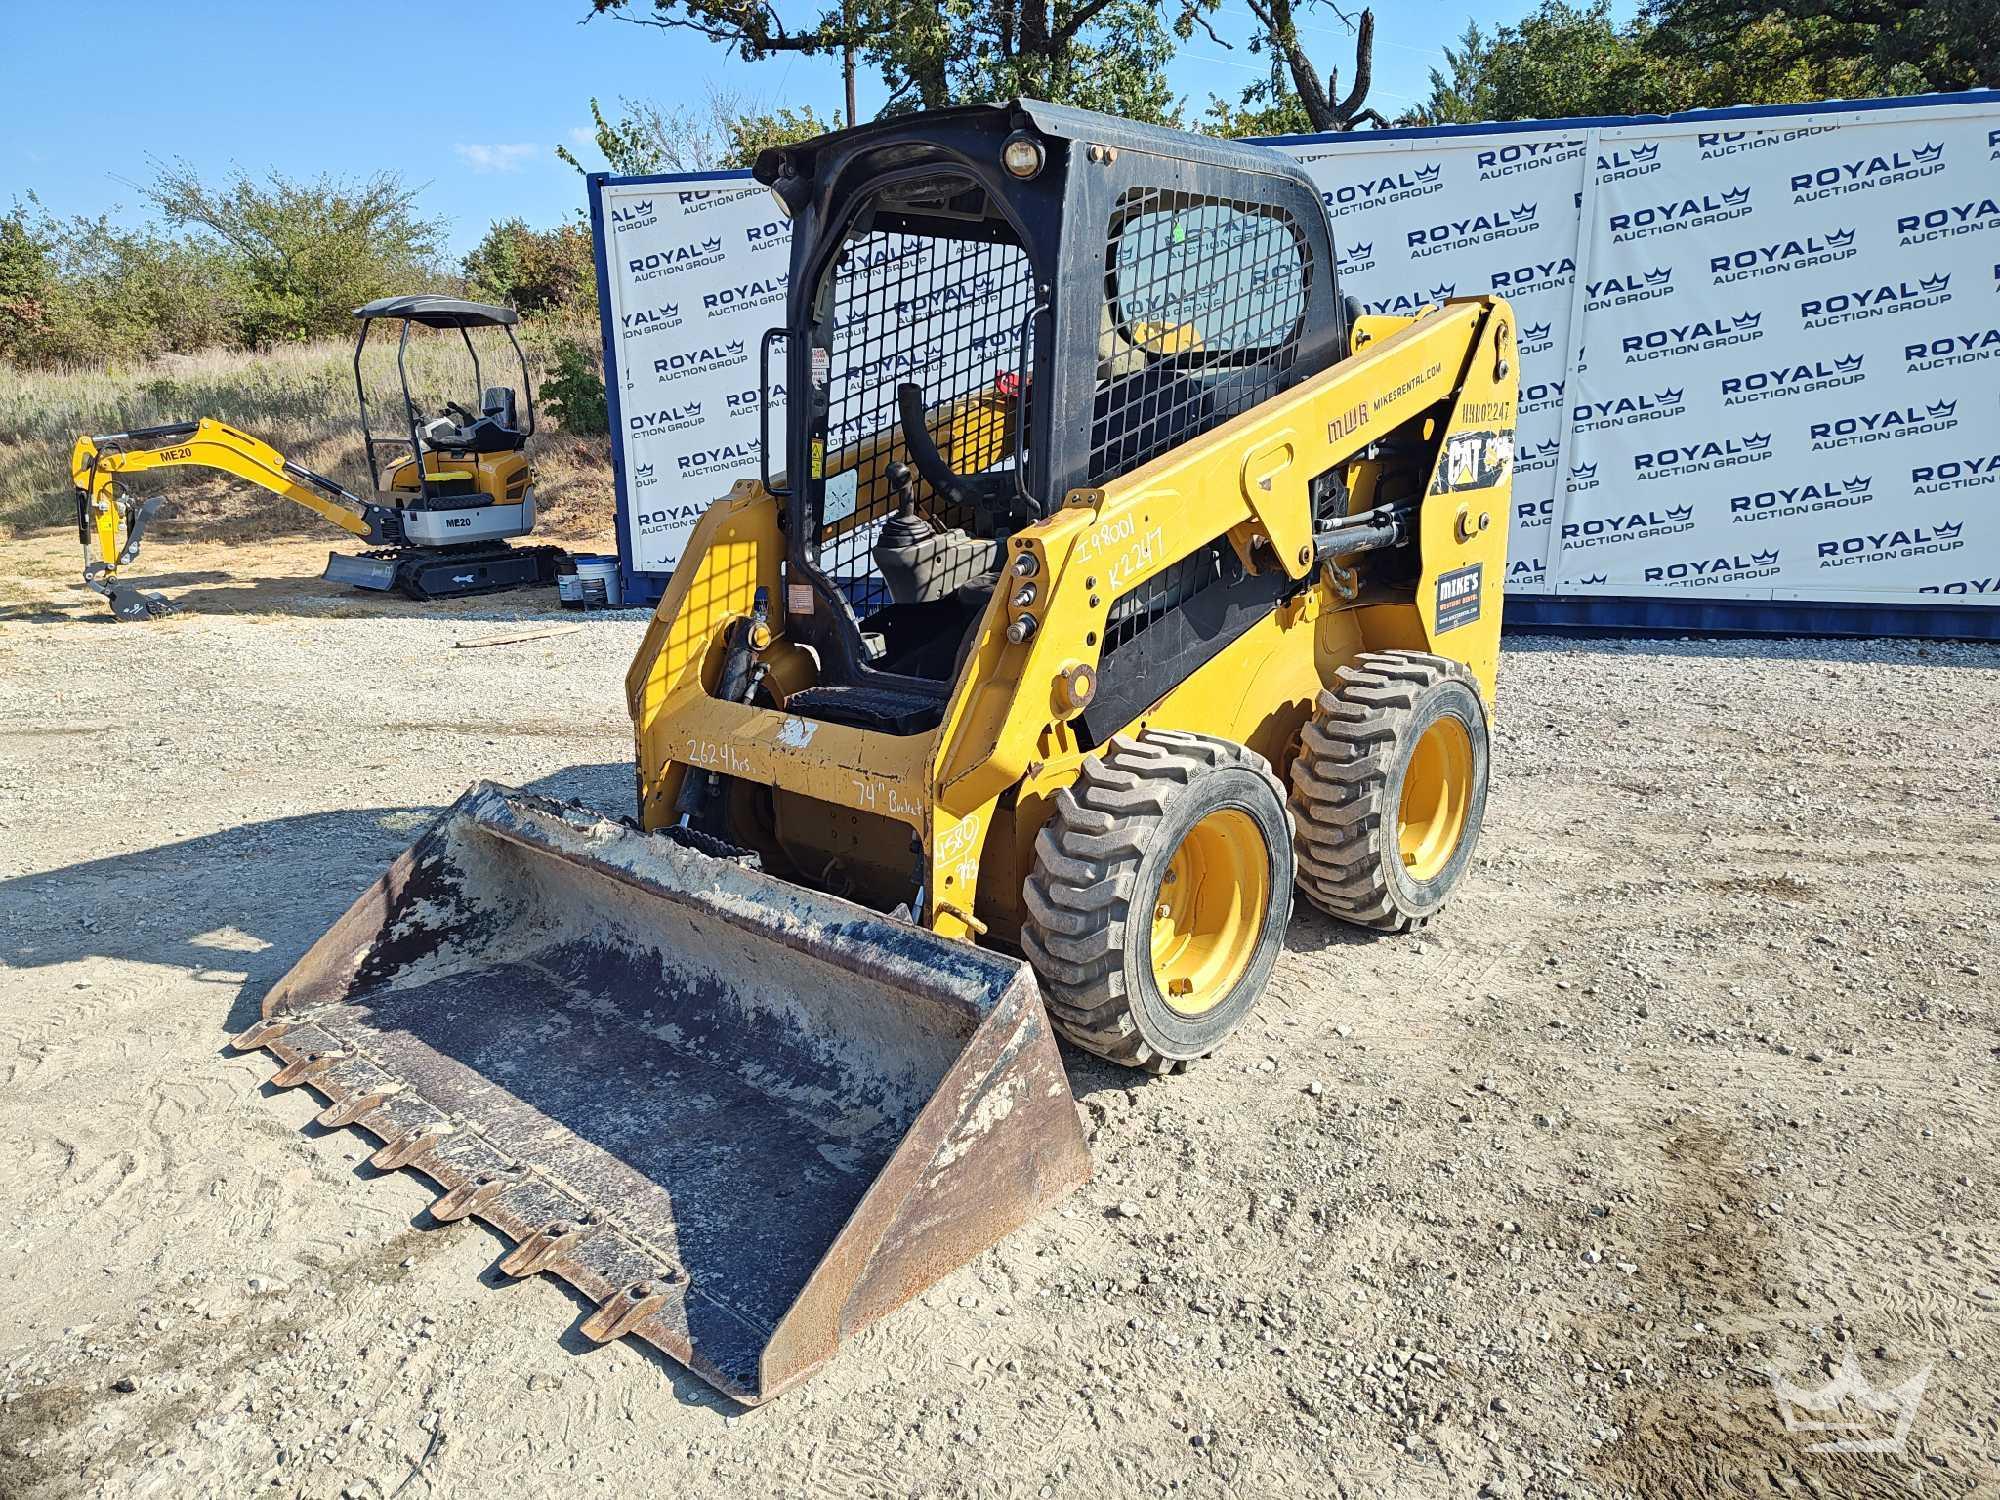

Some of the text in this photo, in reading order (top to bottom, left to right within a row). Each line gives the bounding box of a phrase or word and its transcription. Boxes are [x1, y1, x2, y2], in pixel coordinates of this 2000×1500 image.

[1701, 135, 1779, 161] AUCTION
[1783, 125, 1840, 142] GROU
[1480, 158, 1552, 181] AUCTION
[1602, 162, 1661, 184] GROUP
[1791, 152, 1911, 192] ROYAL
[1793, 163, 1945, 205] AUCTION GROUP
[1321, 173, 1415, 207] ROYAL
[1329, 183, 1443, 219] UCTION GROUP
[684, 194, 734, 216] AUCTION
[1610, 196, 1720, 231] ROYAL
[1897, 198, 2000, 234] ROYA
[617, 216, 658, 233] GROUP
[746, 219, 793, 242] ROY
[1407, 211, 1510, 248] ROYAL
[1613, 206, 1752, 244] AUCTION GROUP
[1899, 221, 1984, 247] AUCTION
[1410, 222, 1540, 259] AUCTION GROUP
[1711, 237, 1824, 272] ROYAL
[629, 244, 703, 273] ROYAL
[634, 253, 726, 284] AUCTION GROUP
[1491, 257, 1576, 289] ROYA
[1713, 248, 1857, 286] AUCTION GROUP
[703, 280, 777, 309] ROYAL
[1585, 275, 1643, 299] YAL
[1615, 286, 1674, 306] GROUP
[1801, 282, 1918, 317] ROYAL
[622, 309, 661, 328] YAL
[707, 300, 758, 318] AUCTION
[1803, 293, 1952, 330] AUCTION GROUP
[644, 318, 683, 334] GROUP
[1622, 319, 1731, 353] ROYAL
[1520, 341, 1554, 355] OUP
[1625, 330, 1763, 364] AUCTION GROUP
[1905, 329, 2000, 360] ROYA
[654, 346, 727, 374] ROYAL
[658, 354, 748, 383] AUCTION GROUP
[1906, 350, 1989, 373] AUCTION
[1373, 363, 1442, 412] MIKESRENTAL.COM
[1722, 362, 1833, 395] ROYAL
[1724, 373, 1865, 406] AUCTION GROUP
[630, 407, 685, 430] OYAL
[1573, 395, 1654, 422] OYAL
[1627, 406, 1686, 424] GROUP
[1810, 407, 1926, 439] ROYAL
[668, 417, 705, 433] GROUP
[1811, 419, 1958, 451] AUCTION GROUP
[160, 447, 192, 463] ME20
[678, 443, 749, 470] ROYAL
[1447, 439, 1483, 486] CAT
[1634, 439, 1742, 470] ROYAL
[1637, 451, 1773, 480] AUCTION GROUP
[1911, 455, 2000, 483] ROYA
[682, 462, 730, 479] AUCTION
[1913, 475, 1995, 495] AUCTION
[1566, 479, 1600, 493] OUP
[1730, 482, 1841, 513] ROYAL
[638, 503, 705, 526] ROYAL
[1732, 494, 1873, 523] AUCTION GROUP
[446, 518, 471, 529] ME20
[641, 519, 688, 536] AUCTION
[1562, 511, 1665, 539] ROYAL
[1563, 522, 1695, 550] AUCTION GROUP
[1817, 528, 1932, 558] ROYAL
[1819, 540, 1964, 568] AUCTION GROUP
[1108, 526, 1164, 592] K2247
[1645, 555, 1751, 582] ROYAL
[1440, 572, 1479, 601] MIKE'S
[1722, 567, 1781, 583] GROUP
